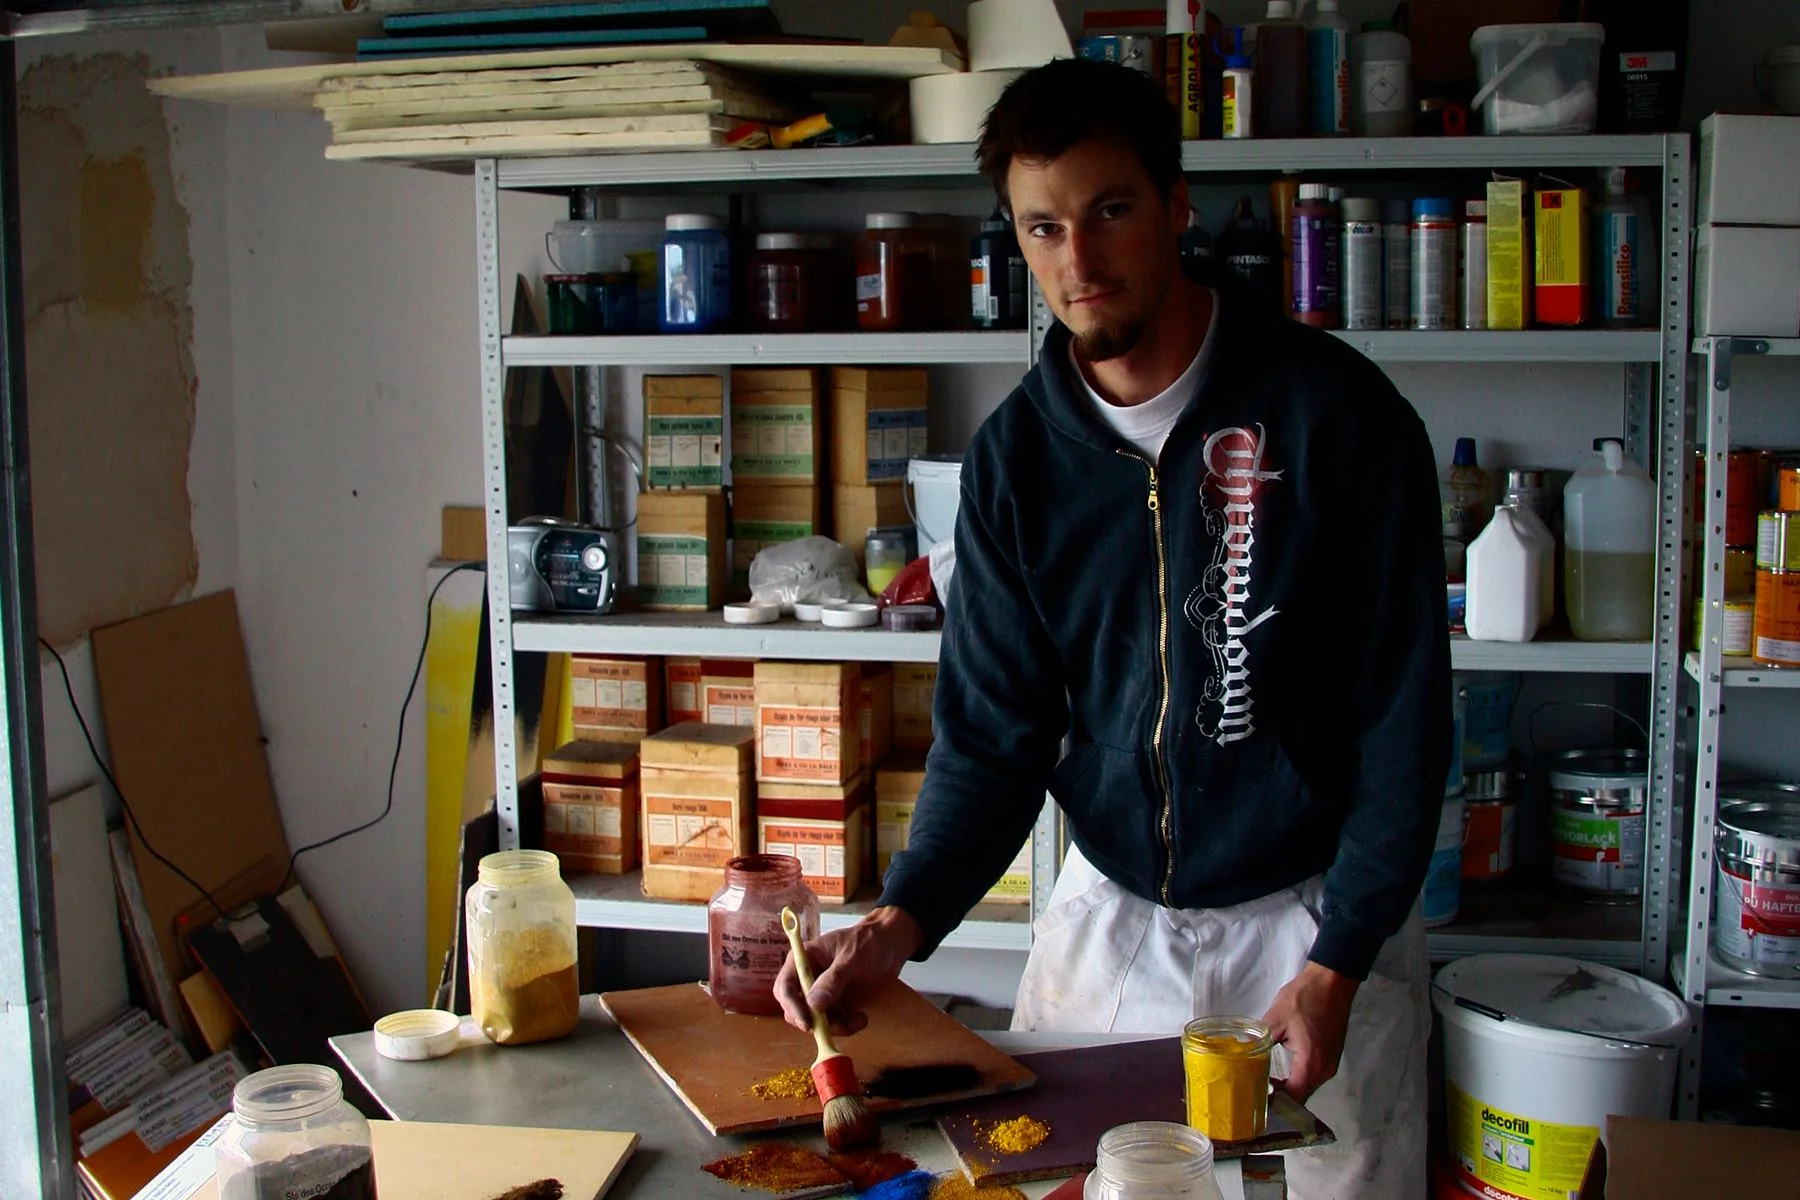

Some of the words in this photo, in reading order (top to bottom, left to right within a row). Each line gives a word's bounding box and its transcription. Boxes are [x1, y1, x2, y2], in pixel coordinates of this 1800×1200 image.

[1626, 57, 1648, 69] 3M
[1202, 421, 1286, 748] Throwdown
[1481, 1108, 1529, 1135] decofill
